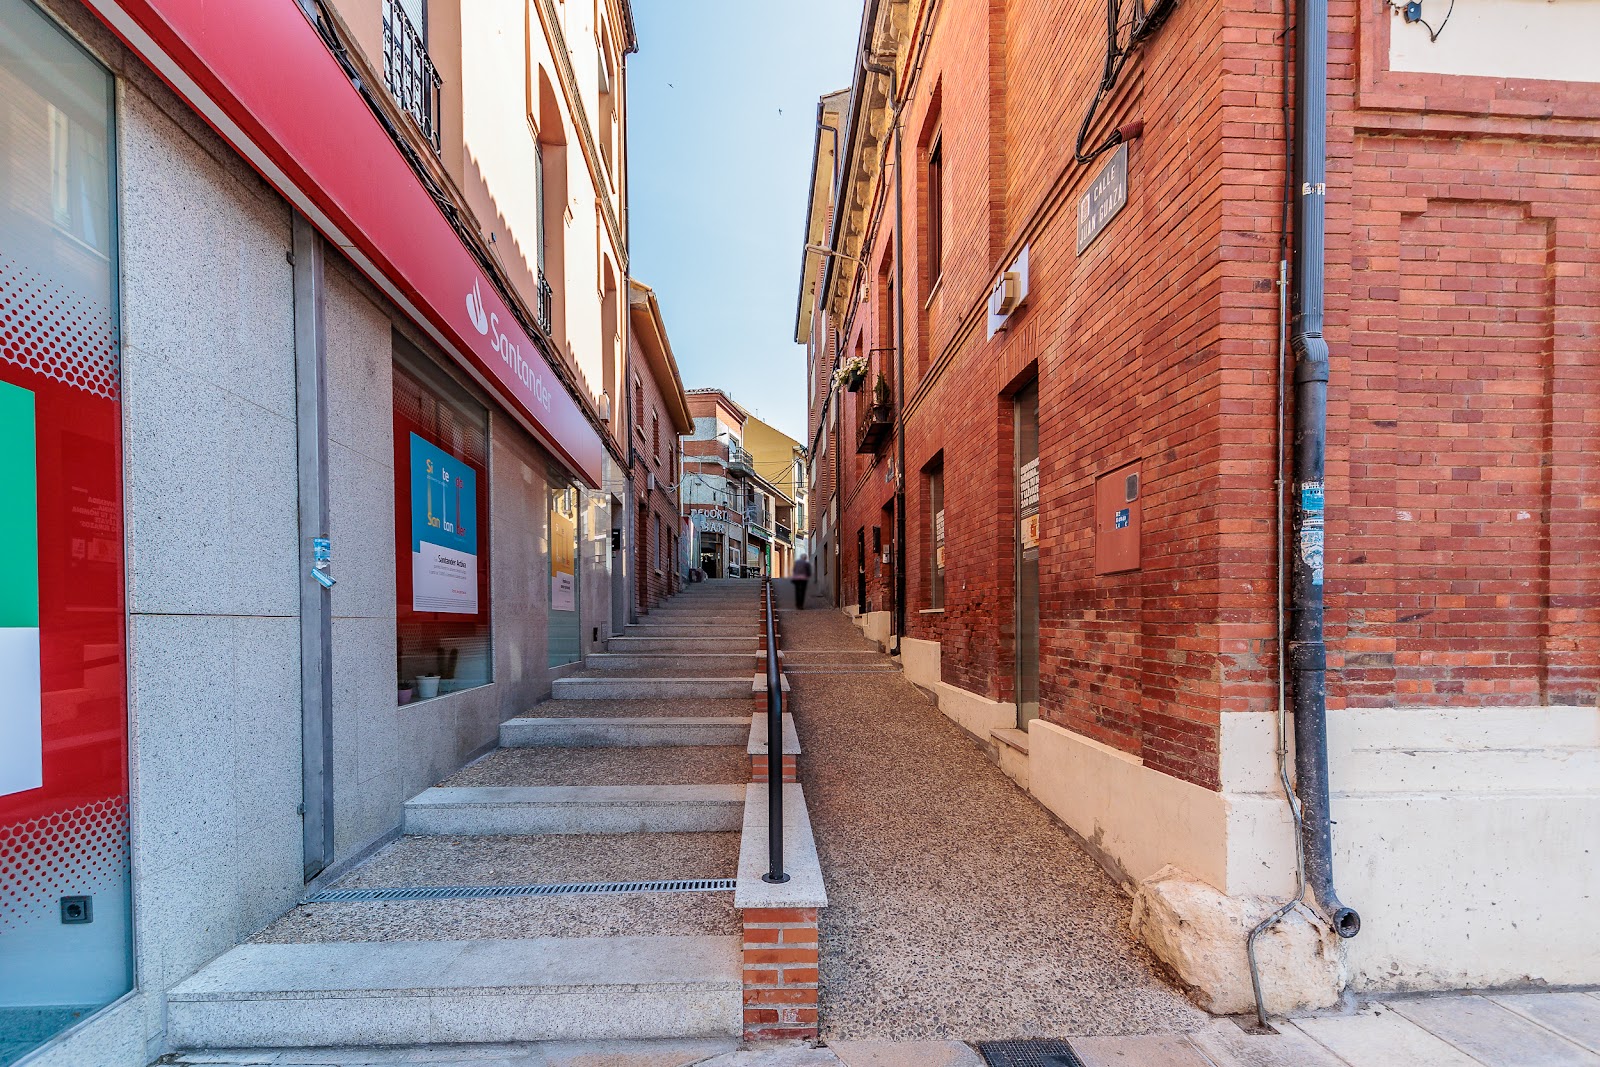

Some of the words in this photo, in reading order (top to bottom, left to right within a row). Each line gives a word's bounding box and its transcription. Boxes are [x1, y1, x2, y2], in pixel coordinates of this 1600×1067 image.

[1093, 164, 1116, 202] CALLE
[1079, 215, 1097, 245] JUAN
[1099, 182, 1123, 223] GUAZA
[490, 312, 552, 413] Santander
[442, 467, 450, 483] te
[700, 521, 724, 533] BAR
